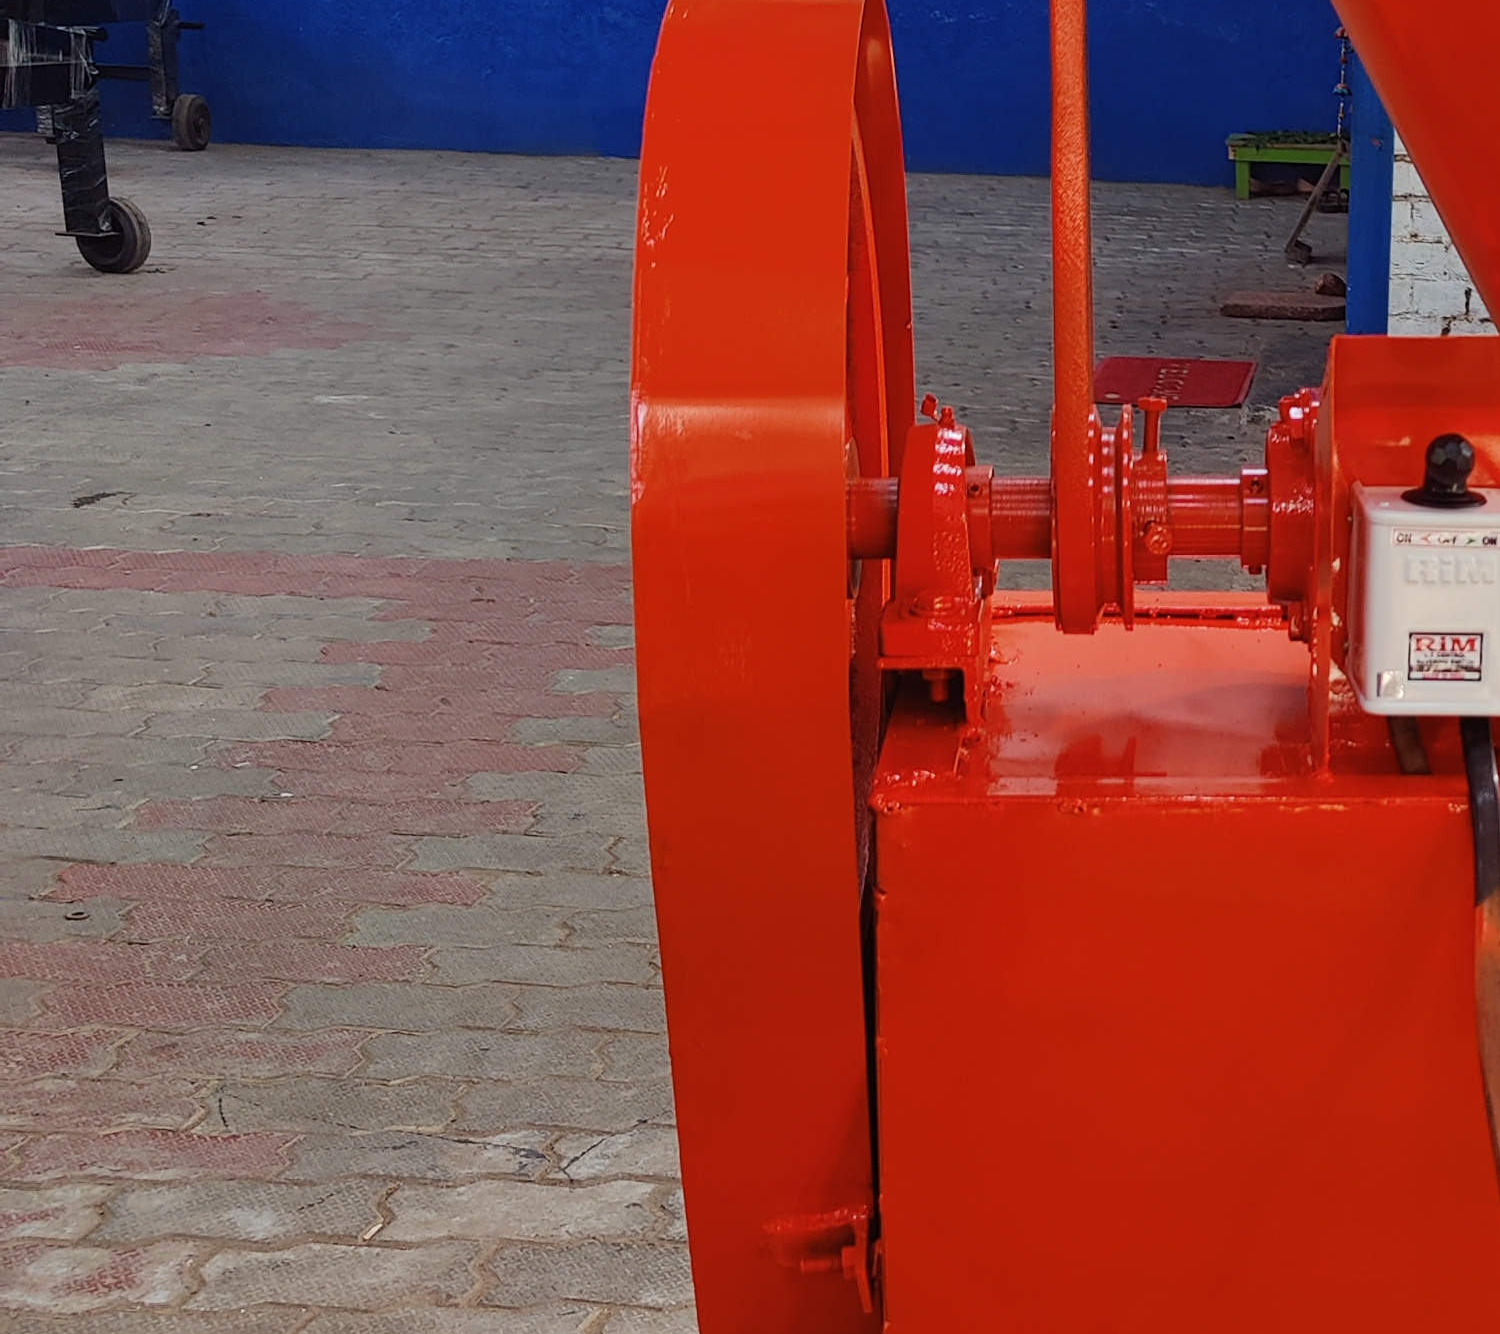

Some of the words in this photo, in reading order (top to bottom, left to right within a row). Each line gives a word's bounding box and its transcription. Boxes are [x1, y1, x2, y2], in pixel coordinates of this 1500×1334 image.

[1397, 533, 1412, 543] ON
[1482, 536, 1498, 546] ON
[1415, 636, 1477, 652] RiM
